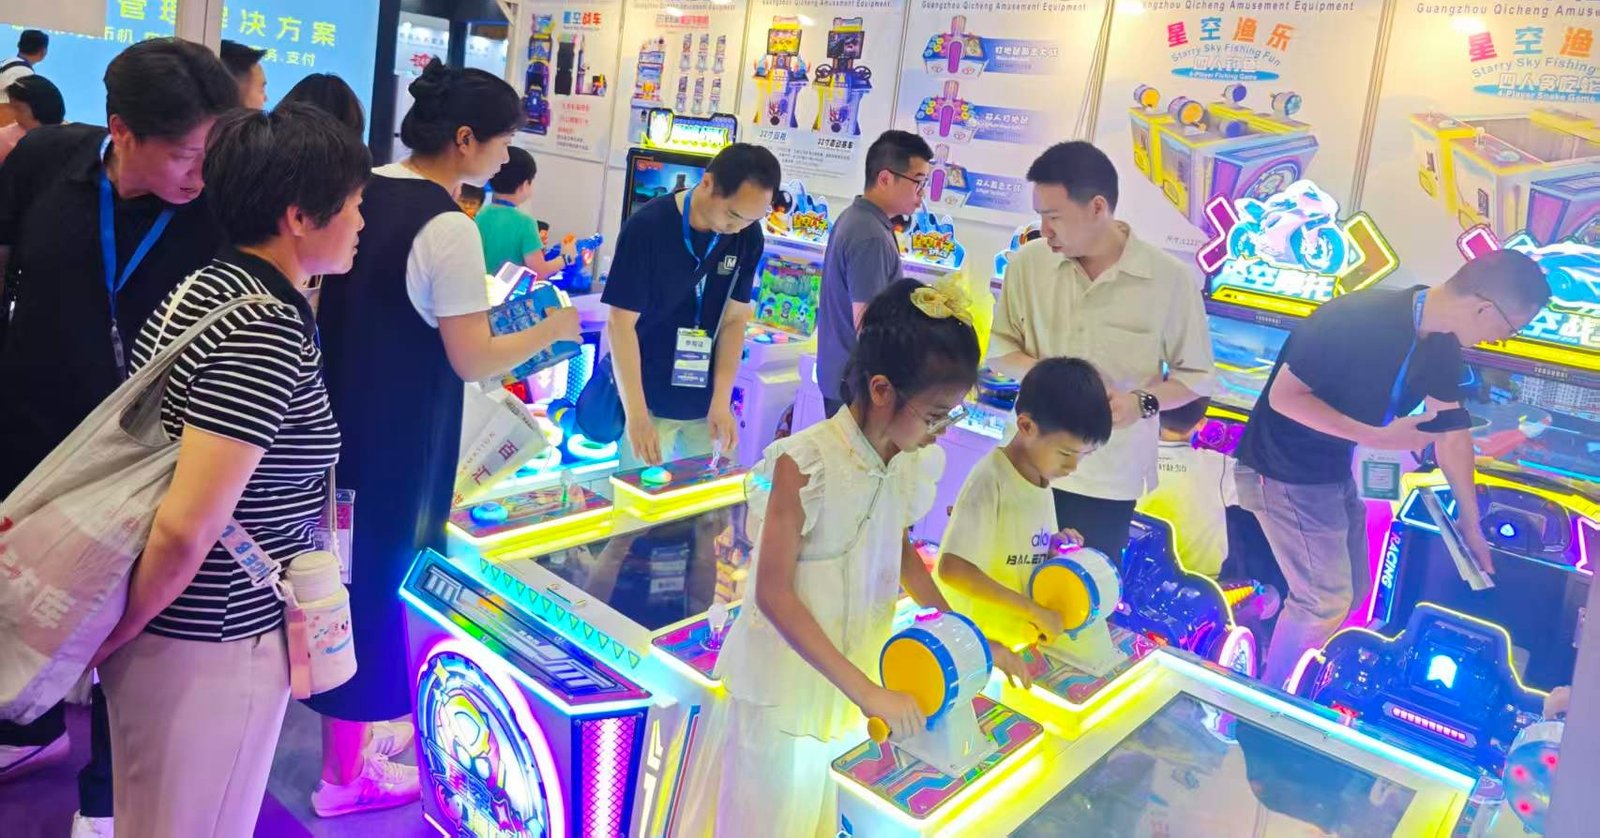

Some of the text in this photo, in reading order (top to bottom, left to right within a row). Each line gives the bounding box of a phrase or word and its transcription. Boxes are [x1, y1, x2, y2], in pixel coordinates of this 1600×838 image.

[921, 1, 1087, 12] Guangzhou Qicheng Amusement Equipment
[1185, 1, 1225, 12] Qicheng
[1229, 1, 1290, 11] Amusement
[1294, 1, 1354, 13] Equipment
[1417, 4, 1487, 15] Guangzhou
[1493, 4, 1549, 18] Qicheng
[1166, 16, 1295, 52] 星空渔乐
[1171, 43, 1282, 67] Starry Sky Fishing Fun
[1472, 57, 1598, 79] Starry Sky Fishing
[1381, 531, 1401, 589] RACING
